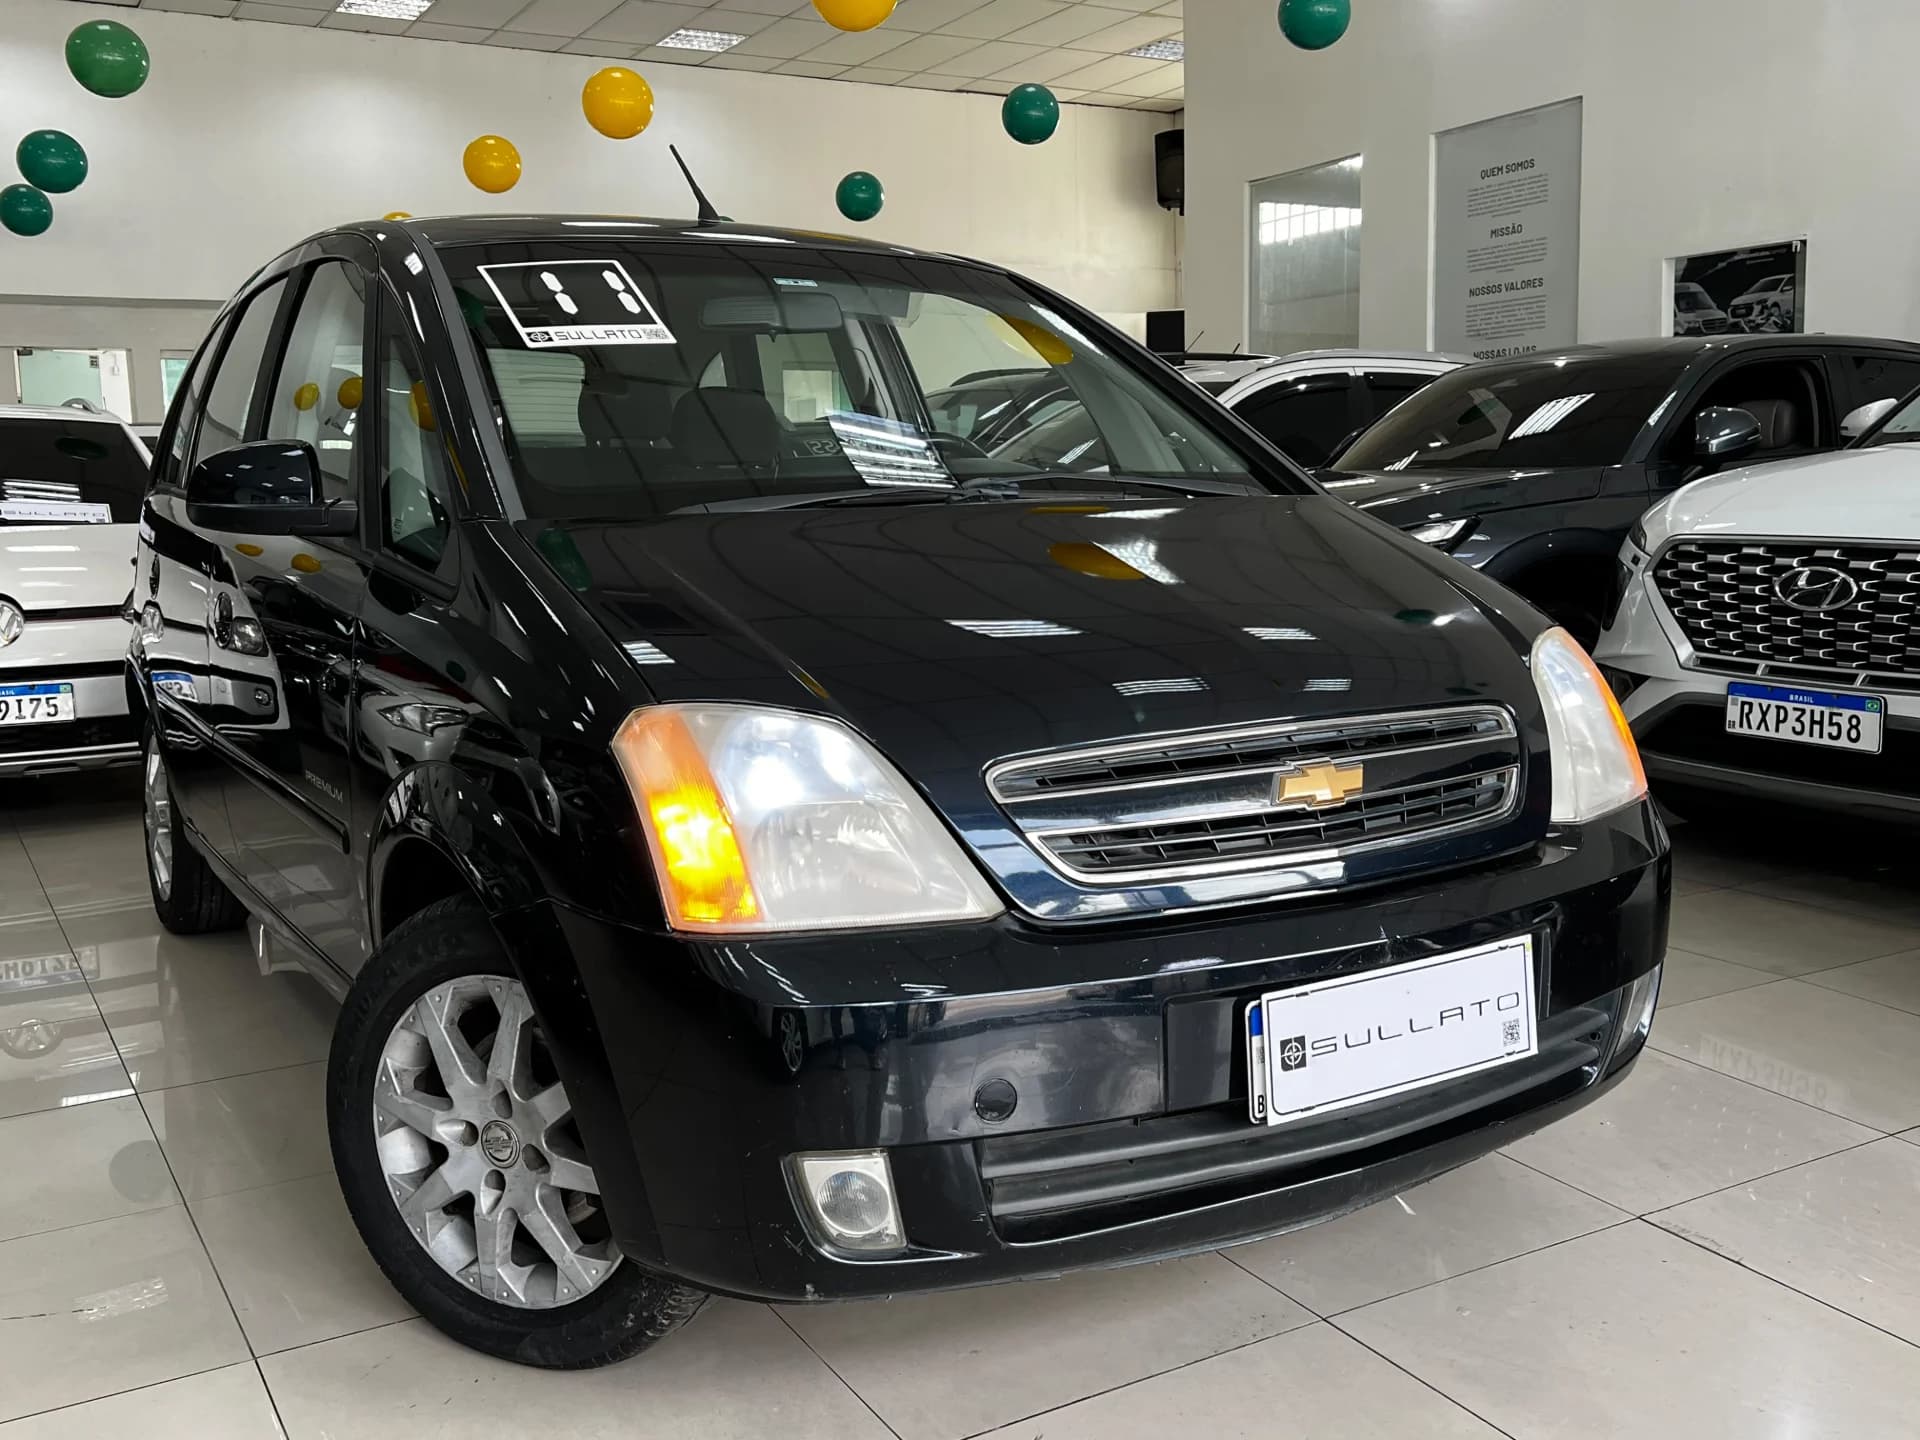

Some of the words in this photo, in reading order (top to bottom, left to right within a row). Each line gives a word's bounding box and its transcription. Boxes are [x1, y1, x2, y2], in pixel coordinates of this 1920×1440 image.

[1480, 166, 1503, 180] QUEM
[1505, 158, 1535, 174] SOMOS
[1490, 223, 1523, 239] MISSÃO
[540, 270, 641, 315] 11
[1469, 283, 1503, 298] NOSSOS
[1505, 277, 1544, 293] VALORES
[555, 329, 643, 341] SULLATO
[1789, 694, 1814, 704] BRASIL
[1738, 701, 1861, 744] RXP3H58
[305, 769, 344, 803] PREMIUM
[1312, 991, 1520, 1057] SULLATO
